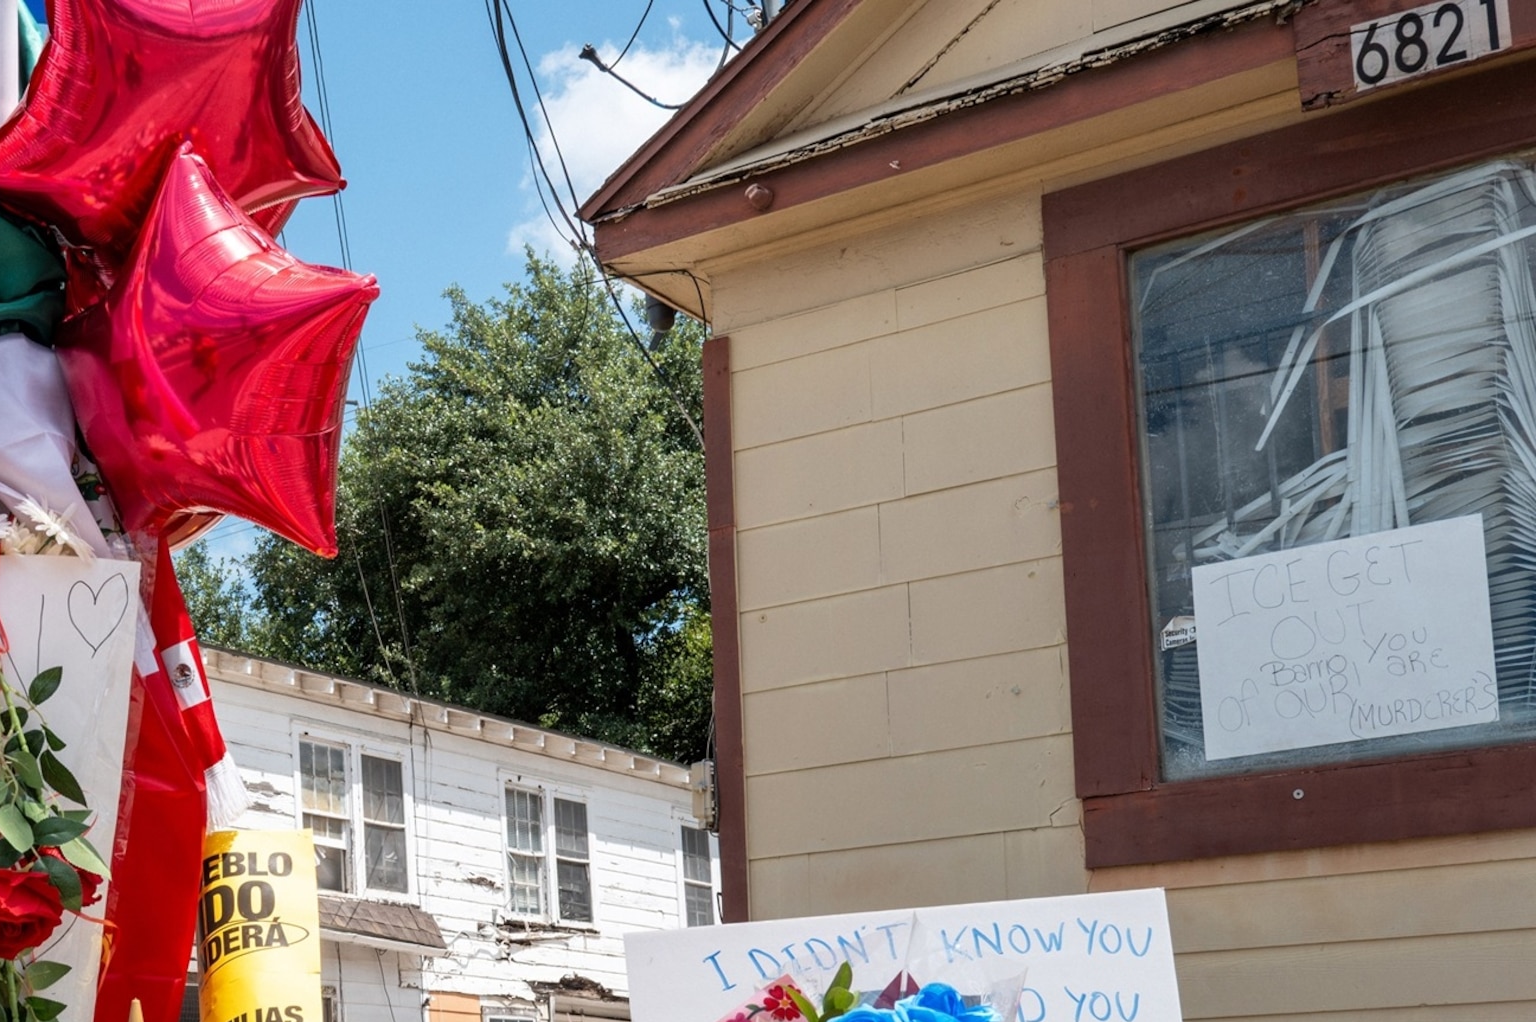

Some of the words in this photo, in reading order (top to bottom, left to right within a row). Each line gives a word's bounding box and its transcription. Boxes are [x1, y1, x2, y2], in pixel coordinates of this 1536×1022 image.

[1356, 0, 1501, 85] 6821
[1210, 558, 1310, 626] ICE
[1326, 539, 1424, 597] GET
[1270, 600, 1375, 660] OUT
[1274, 673, 1354, 720] OUR
[203, 851, 293, 887] EBLO
[703, 949, 737, 992] I
[747, 921, 909, 982] DIDN'T
[940, 920, 1066, 964] KNOW
[1075, 915, 1153, 958] YOU
